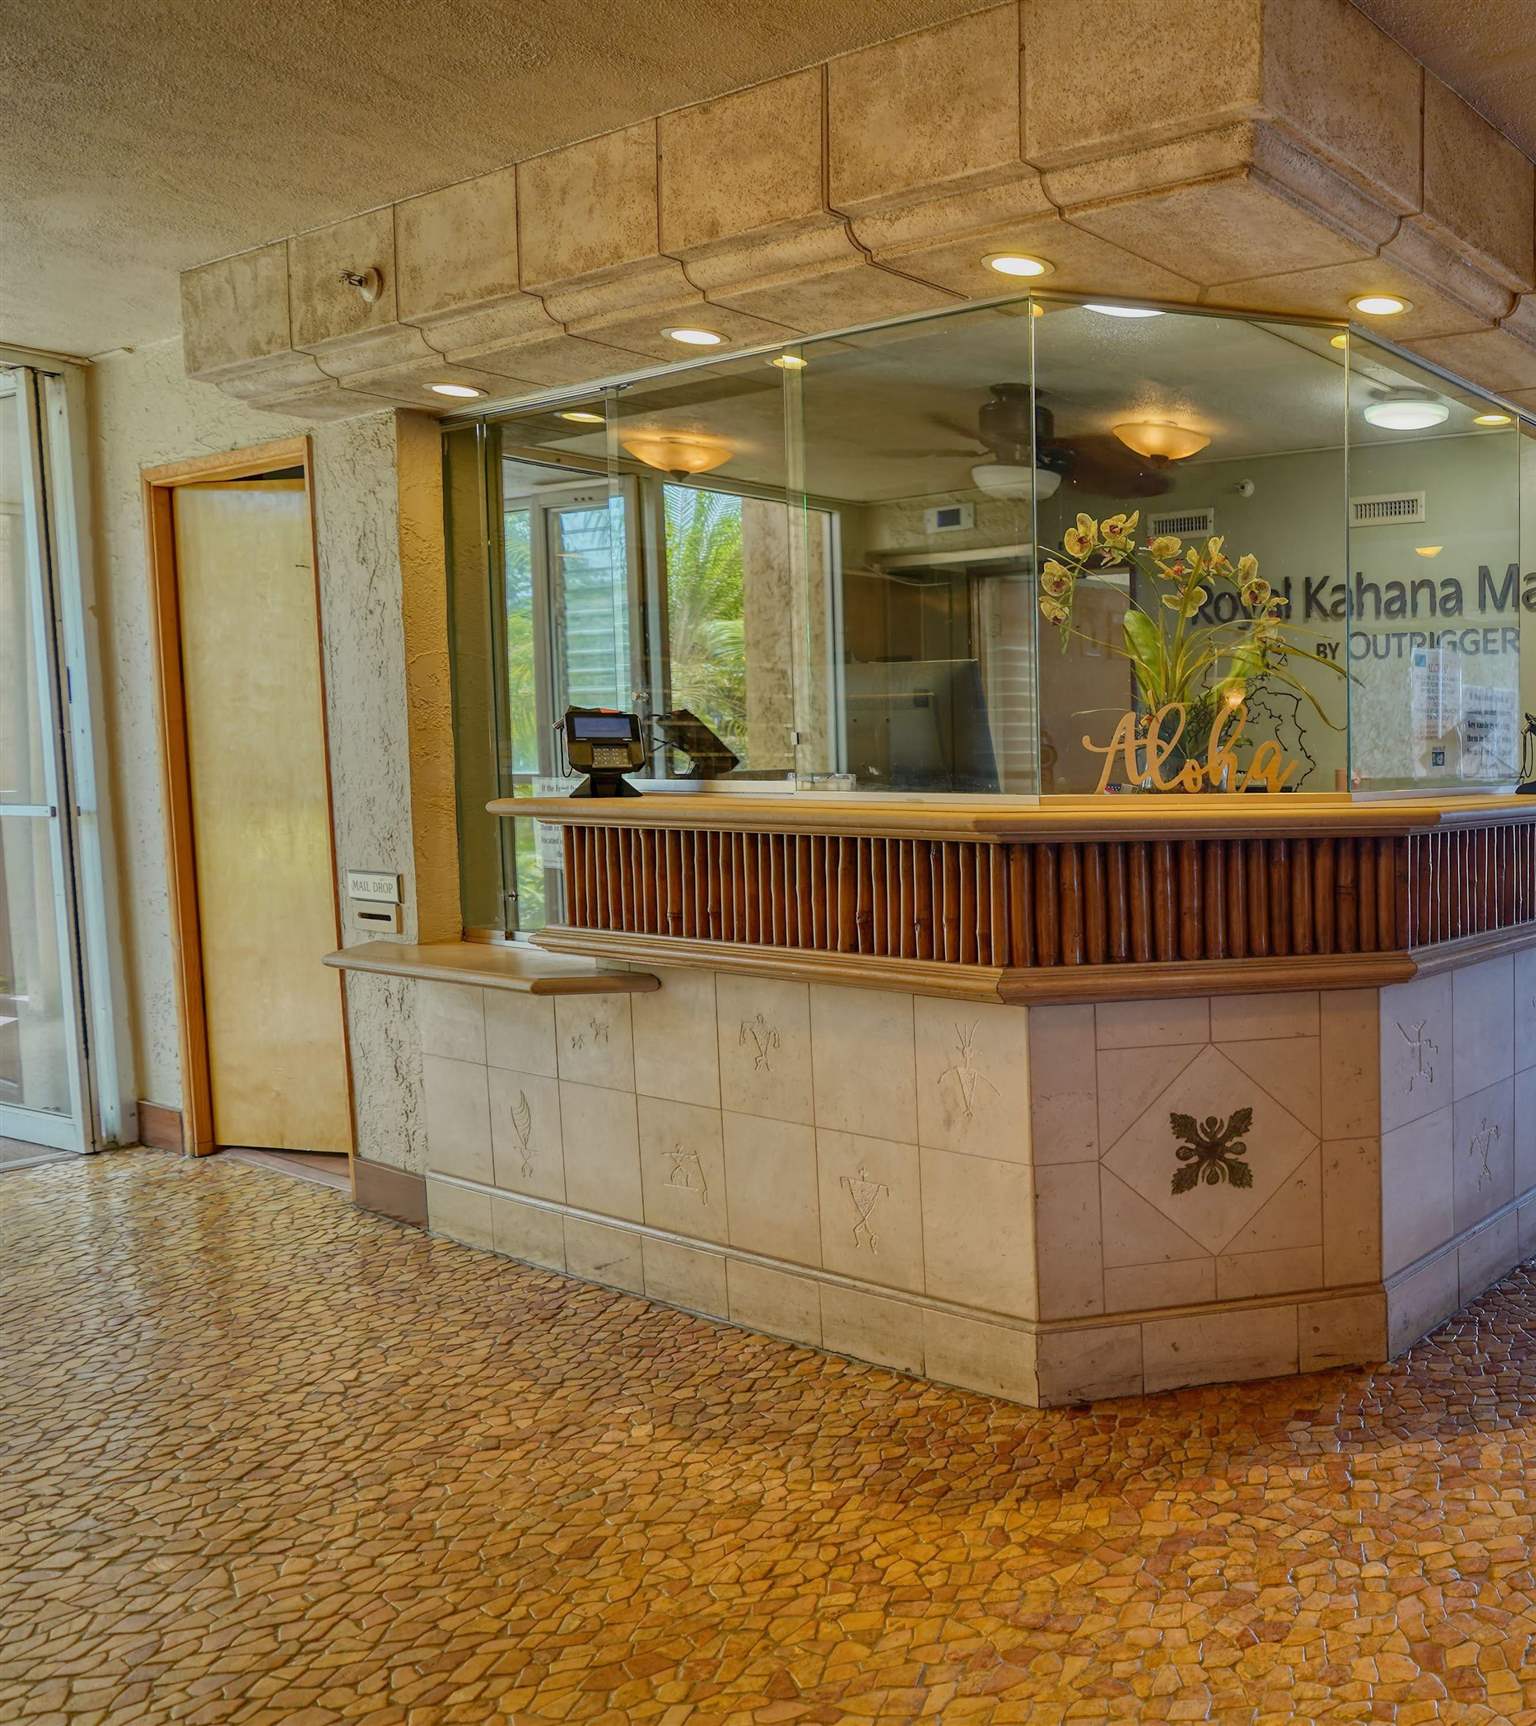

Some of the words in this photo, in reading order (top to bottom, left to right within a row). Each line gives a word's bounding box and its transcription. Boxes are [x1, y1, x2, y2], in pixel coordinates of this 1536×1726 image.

[1304, 571, 1464, 622] Kahana
[1315, 642, 1341, 661] BY
[1349, 626, 1520, 660] OUTRIGGER
[1081, 701, 1298, 794] Aloha
[352, 880, 371, 892] MAIL
[373, 881, 394, 894] DROP
